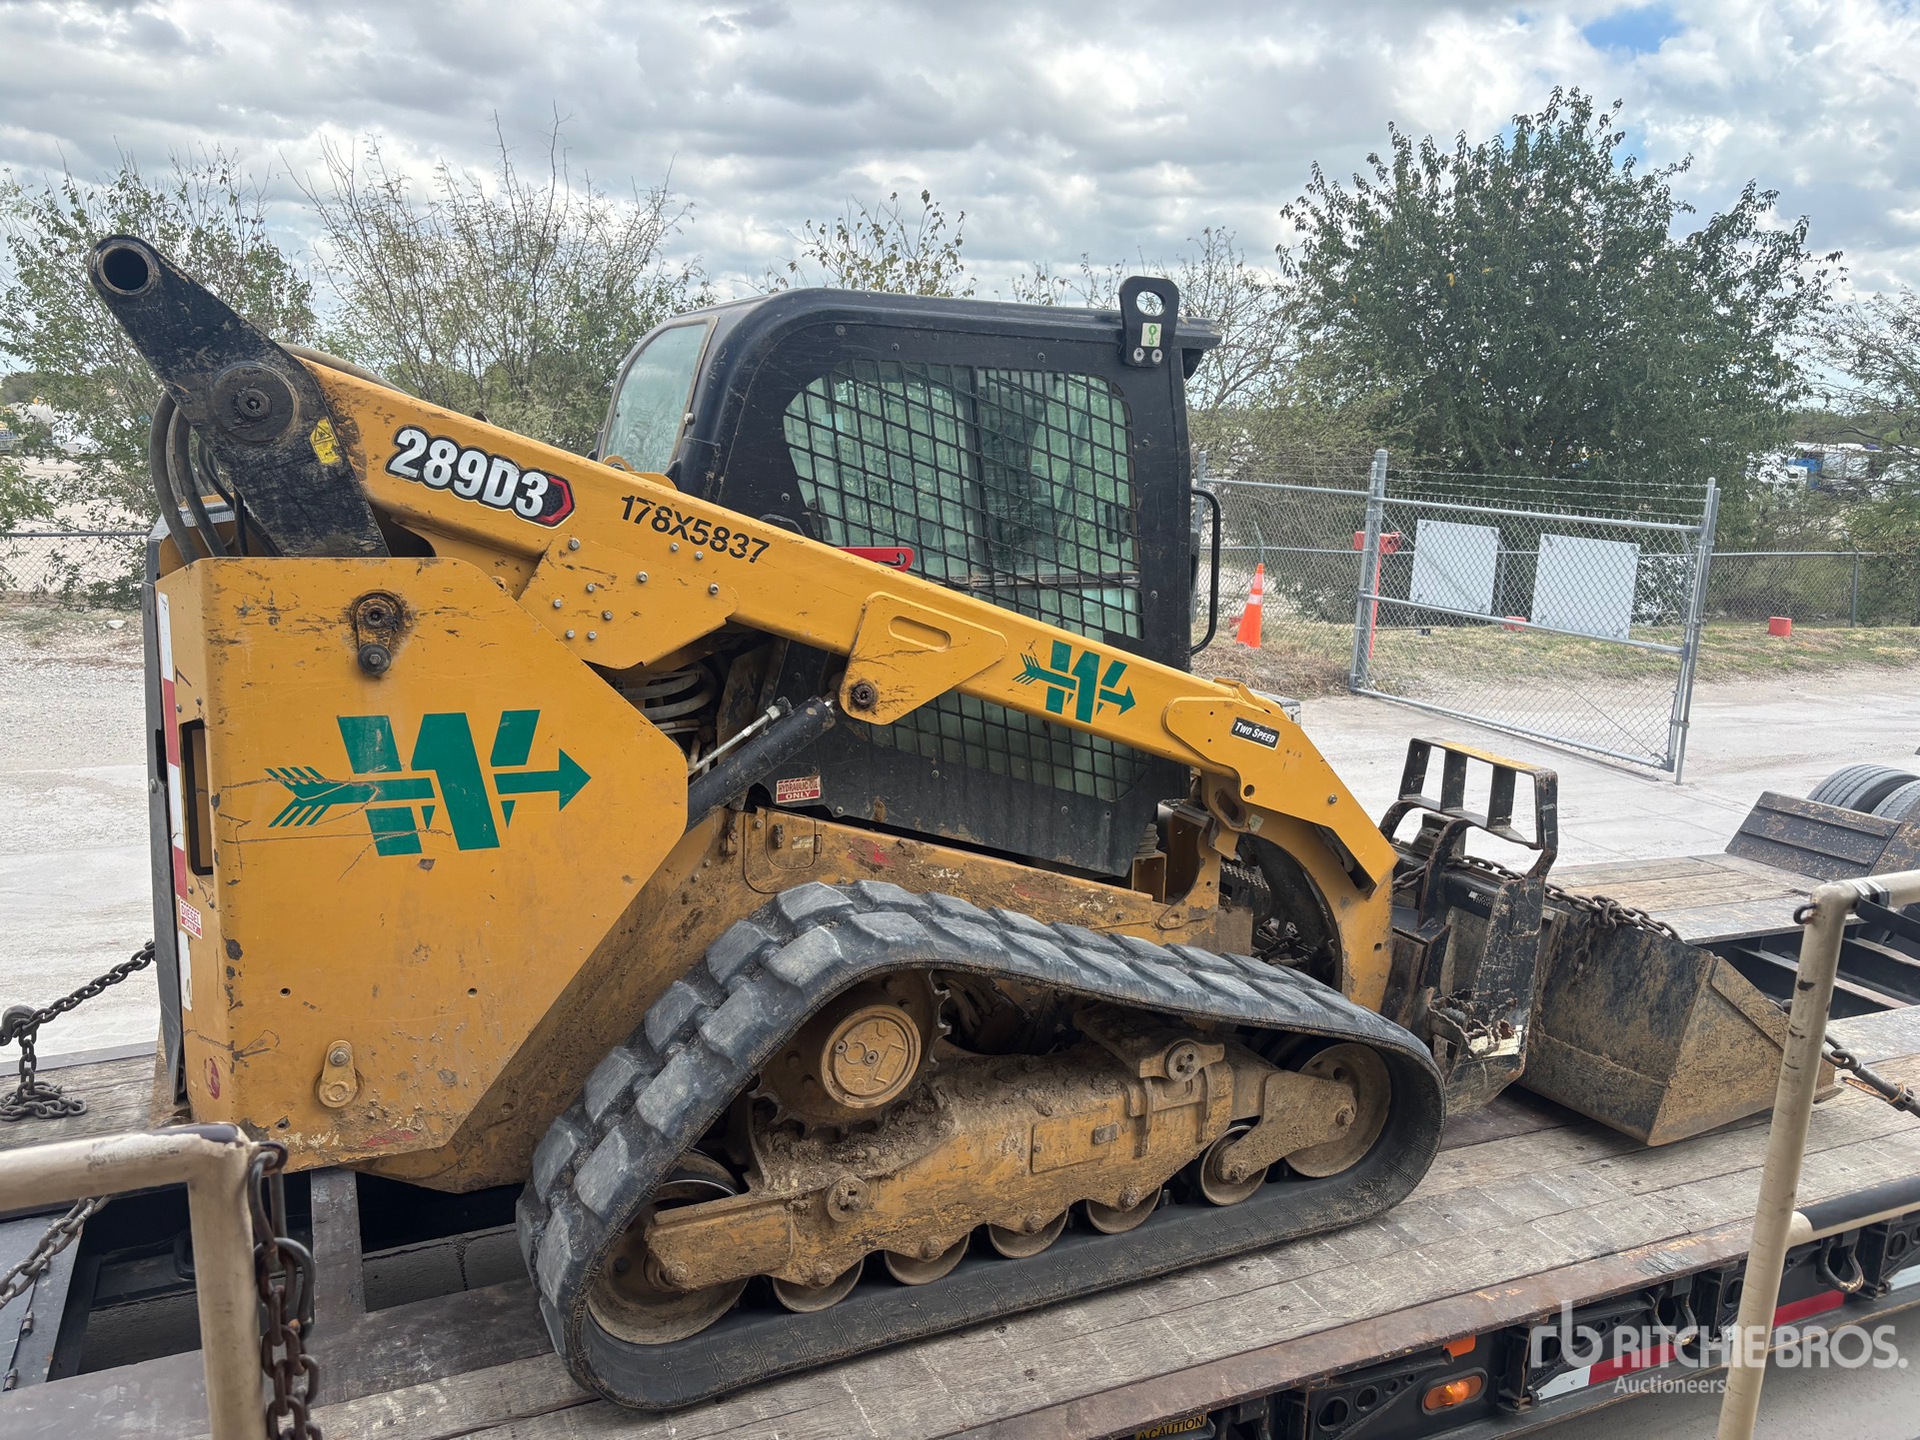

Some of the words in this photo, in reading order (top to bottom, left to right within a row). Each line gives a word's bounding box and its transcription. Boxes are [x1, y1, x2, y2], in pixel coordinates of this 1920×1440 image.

[389, 428, 549, 517] 289D3
[621, 495, 770, 563] 178X5837
[785, 791, 811, 800] ONLY
[1149, 1415, 1204, 1439] CAUTION
